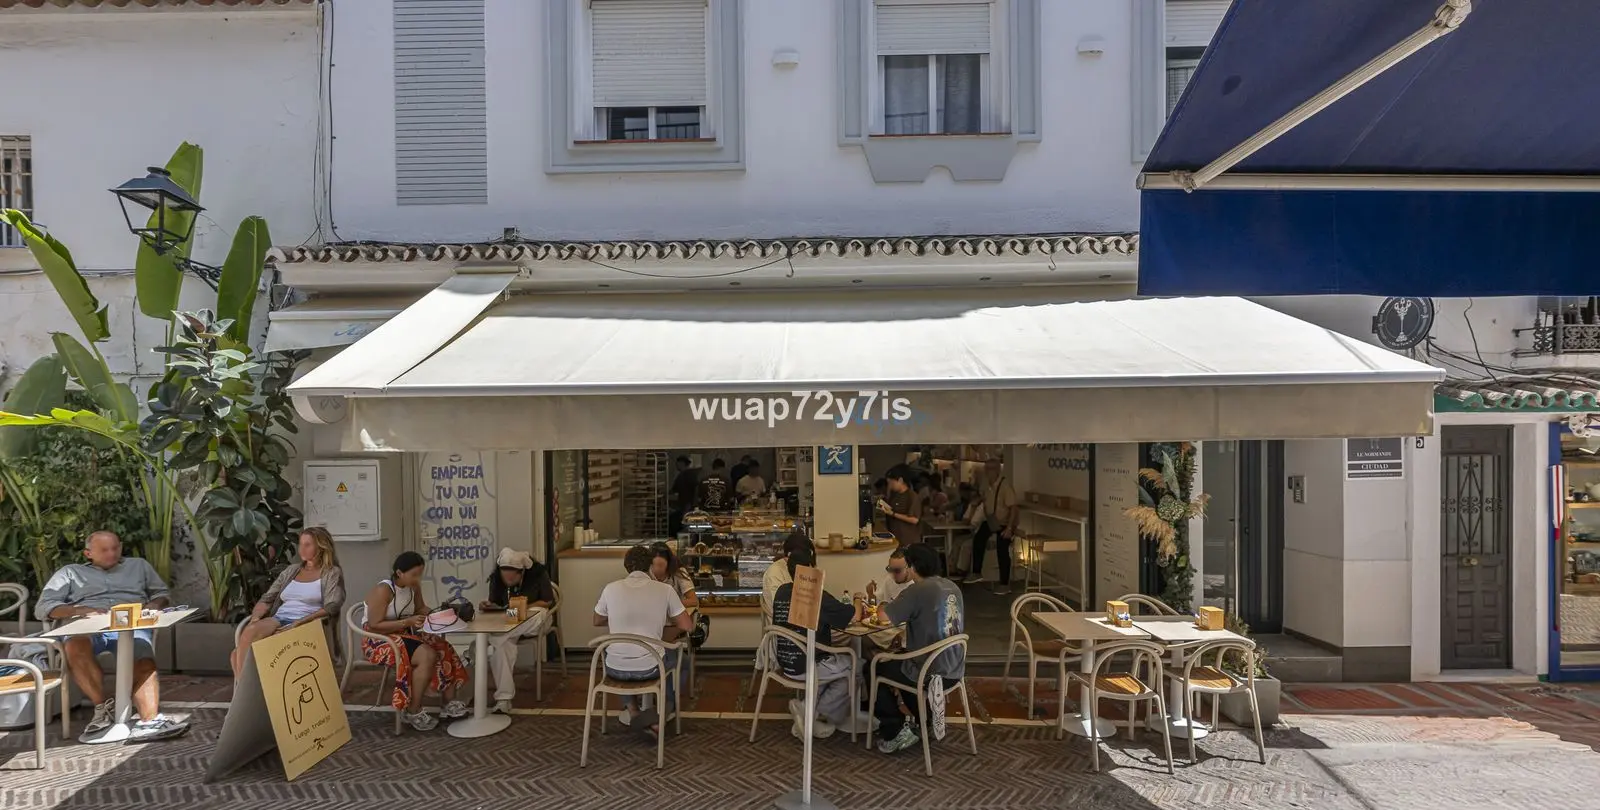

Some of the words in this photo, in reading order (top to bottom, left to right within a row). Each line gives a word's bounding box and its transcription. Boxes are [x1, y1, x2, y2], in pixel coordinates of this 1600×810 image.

[431, 464, 483, 480] EMPIEZA
[435, 485, 453, 500] TU
[457, 484, 479, 499] DIA
[427, 506, 453, 520] CON
[459, 506, 477, 519] UN
[436, 525, 480, 540] SORBO
[428, 545, 489, 561] PERFECTO
